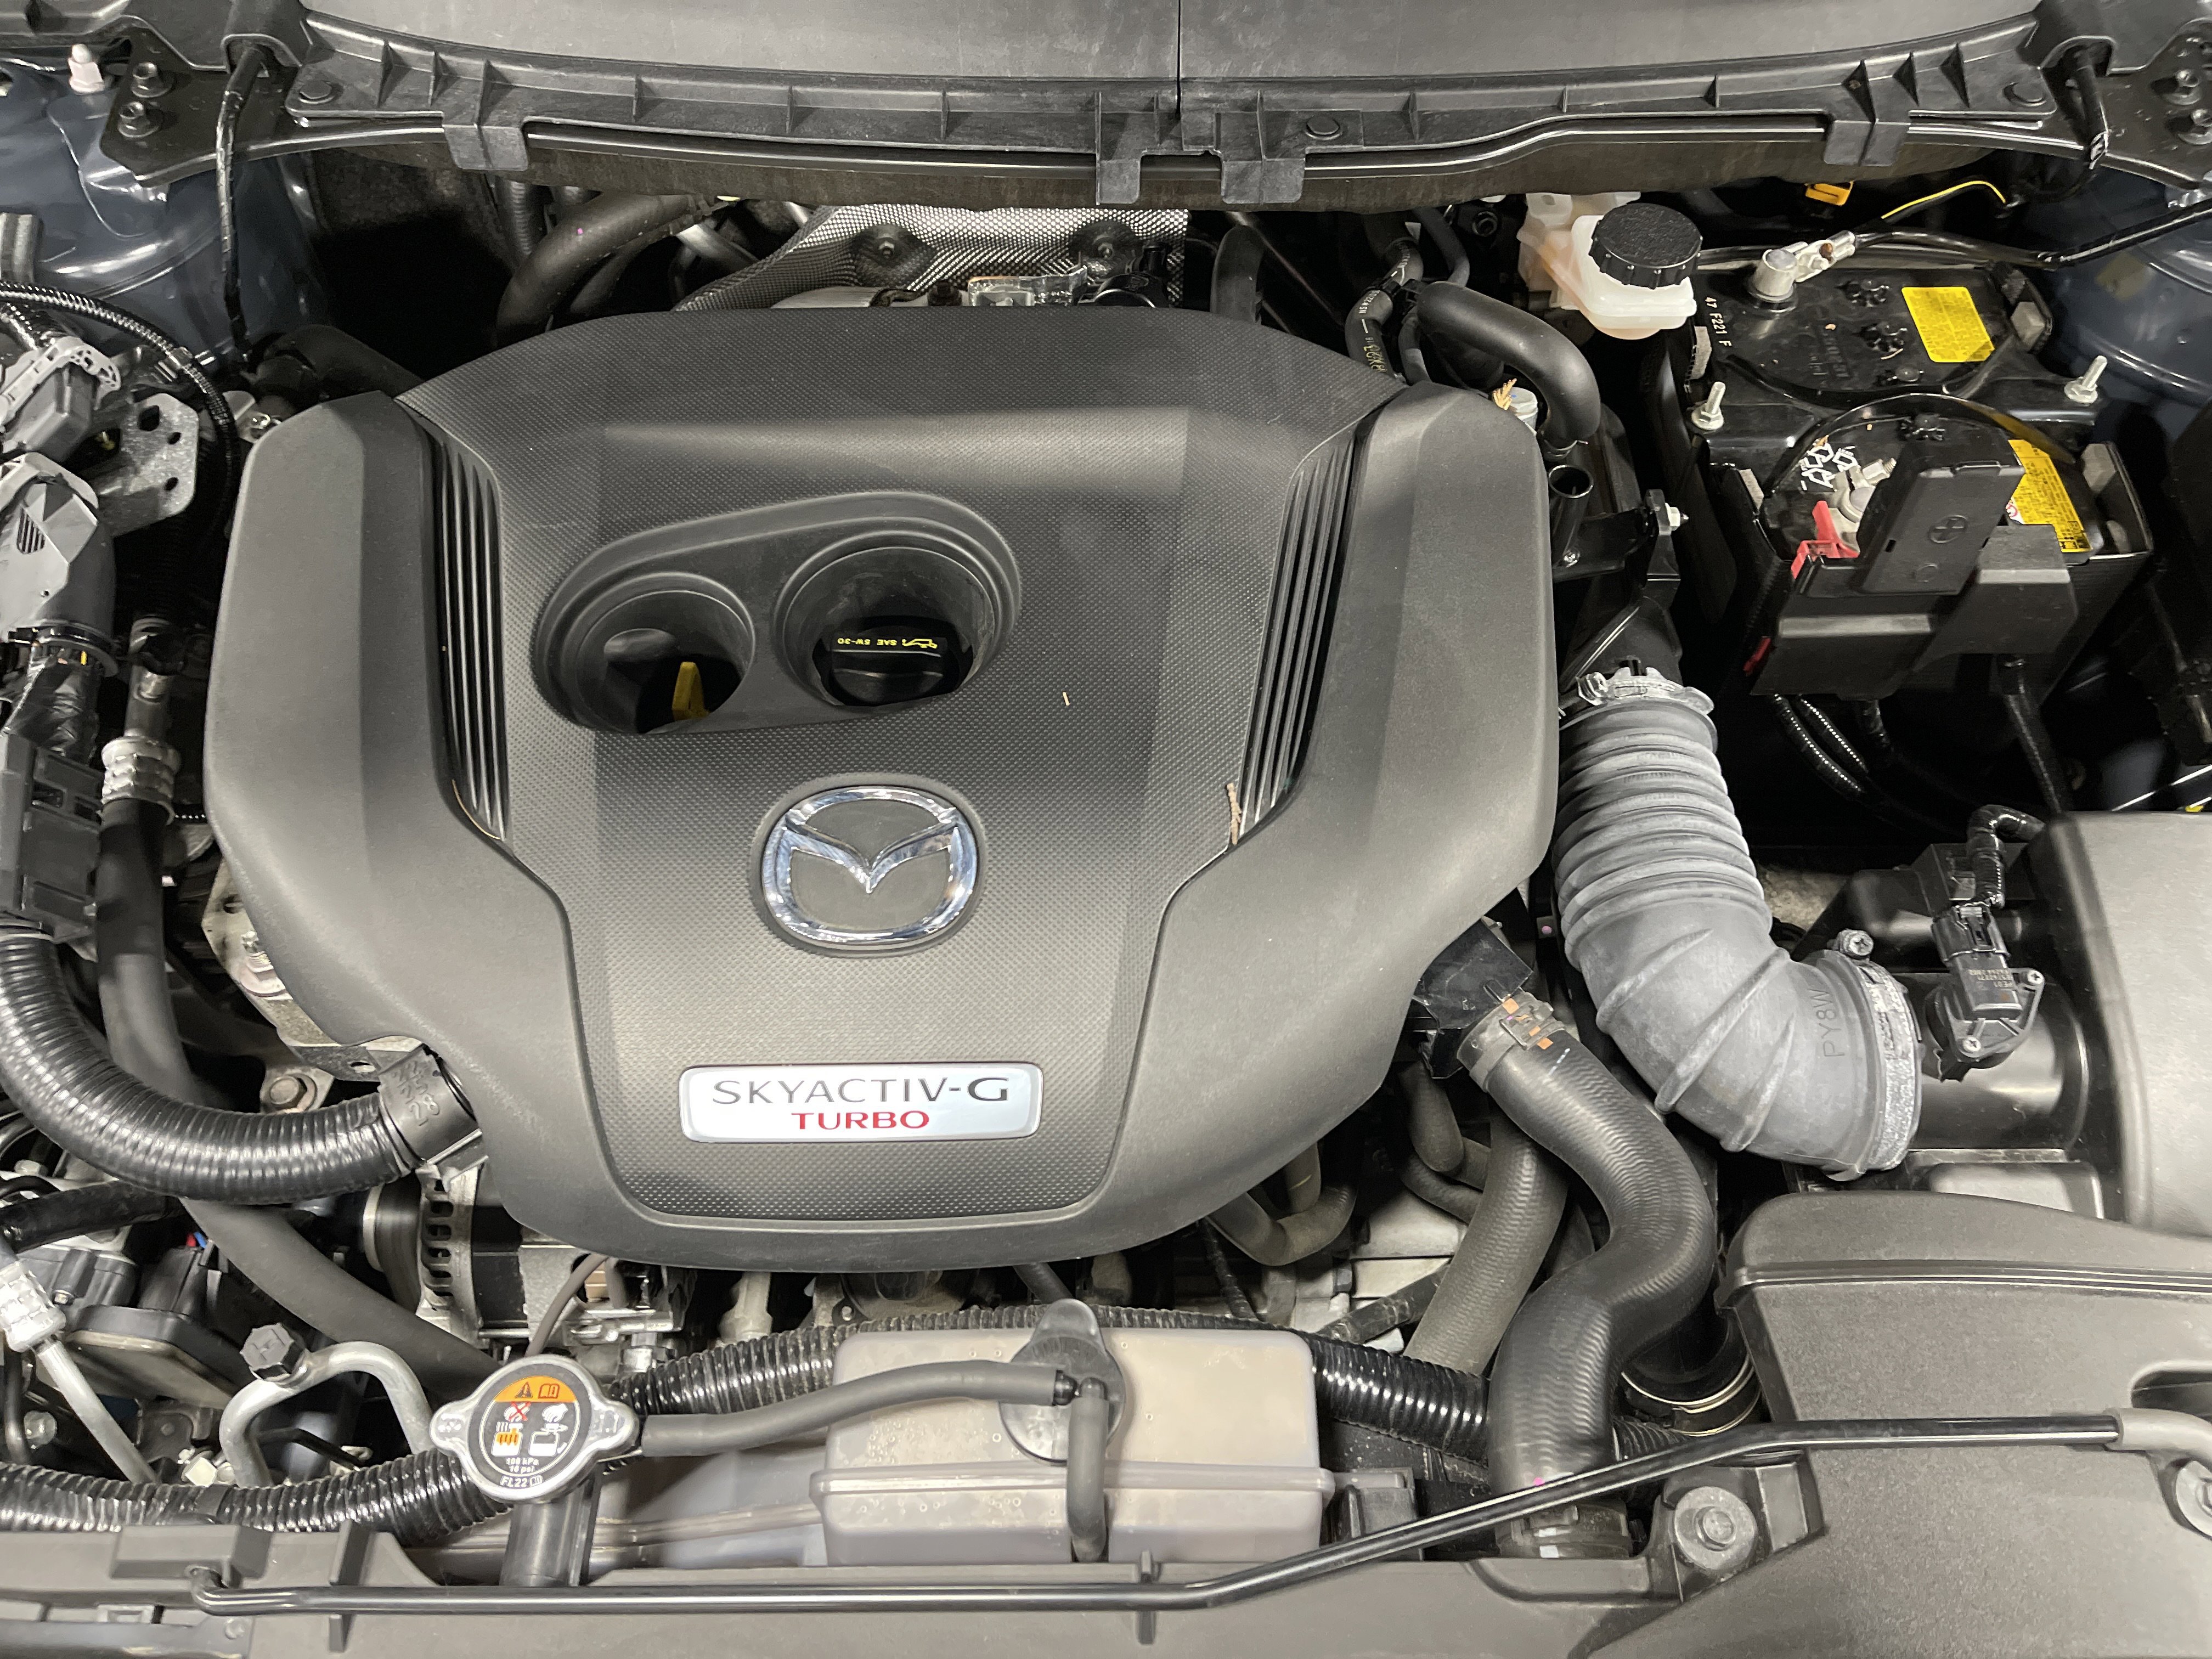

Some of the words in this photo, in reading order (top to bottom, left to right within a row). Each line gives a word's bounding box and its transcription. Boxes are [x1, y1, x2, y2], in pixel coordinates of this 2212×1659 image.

[1709, 313, 1728, 334] F221
[837, 637, 871, 646] 5W-30
[1807, 989, 1846, 1057] PY8W
[712, 1077, 1009, 1105] SKYACTIV-G
[408, 1093, 441, 1126] 28
[791, 1110, 930, 1131] TURBO
[522, 1457, 540, 1466] kPa
[500, 1475, 528, 1488] FL22
